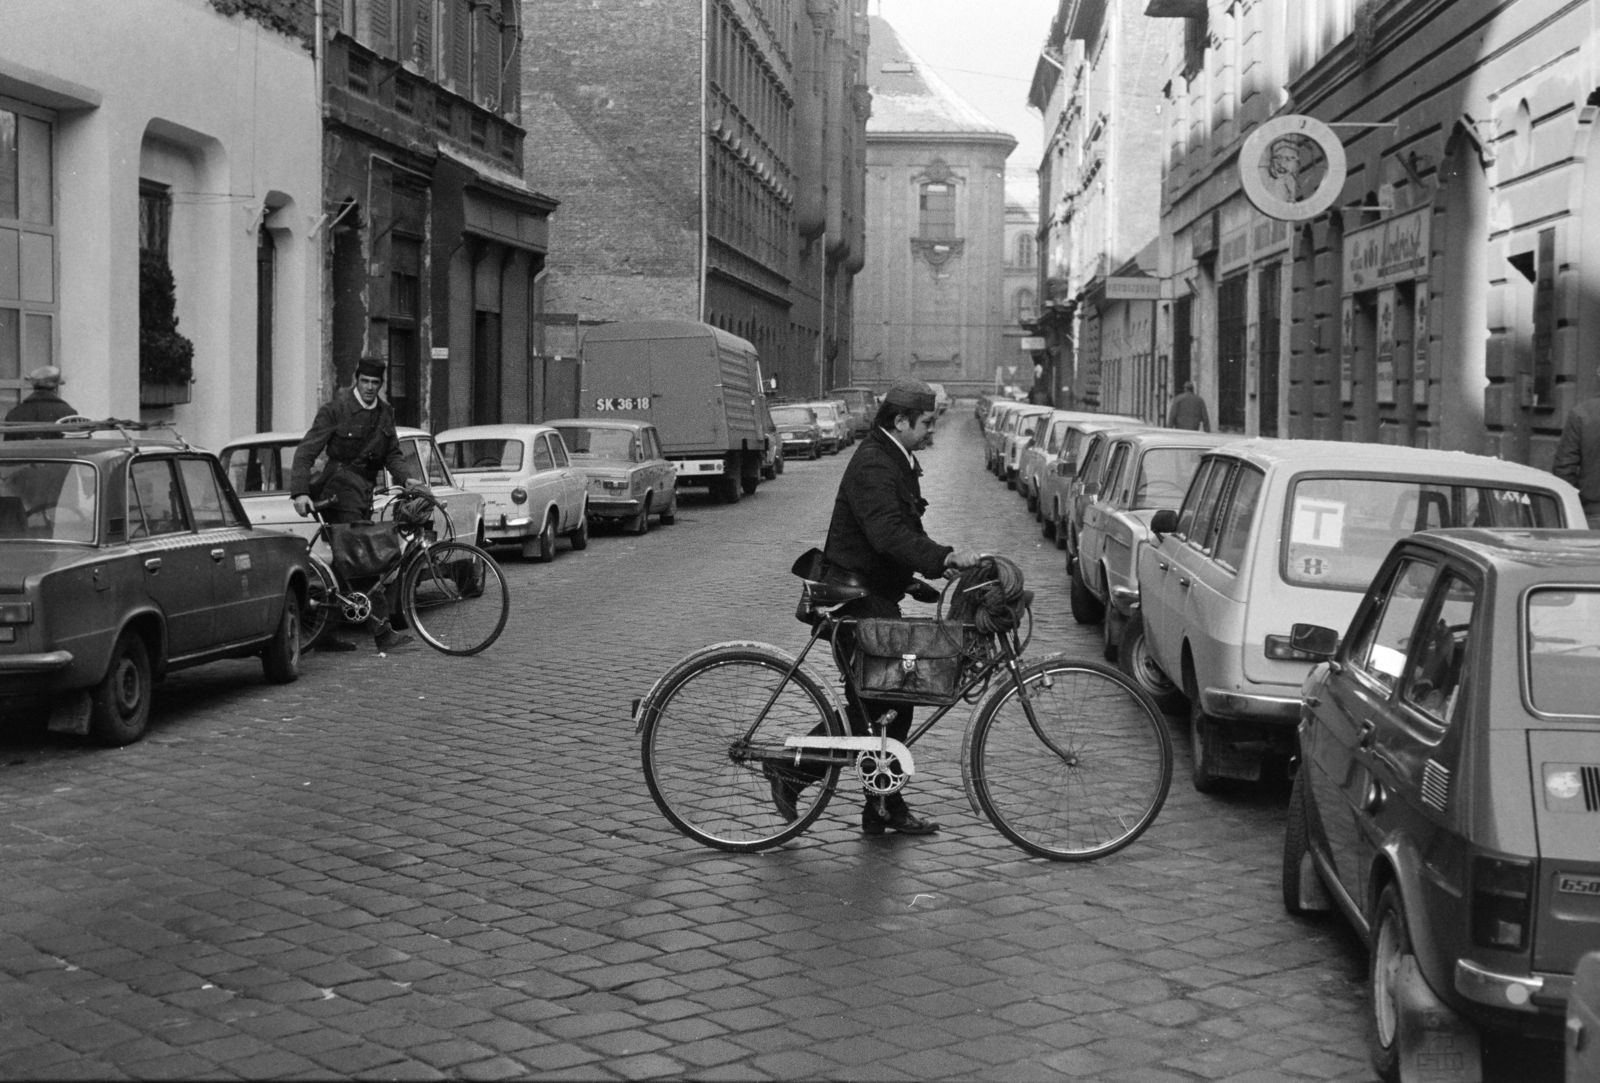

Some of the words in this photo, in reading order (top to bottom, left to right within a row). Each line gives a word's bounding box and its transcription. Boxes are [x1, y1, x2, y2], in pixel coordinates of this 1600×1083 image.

[597, 398, 615, 411] SK
[1300, 504, 1339, 540] T
[1303, 557, 1323, 575] H
[1561, 879, 1600, 893] 650
